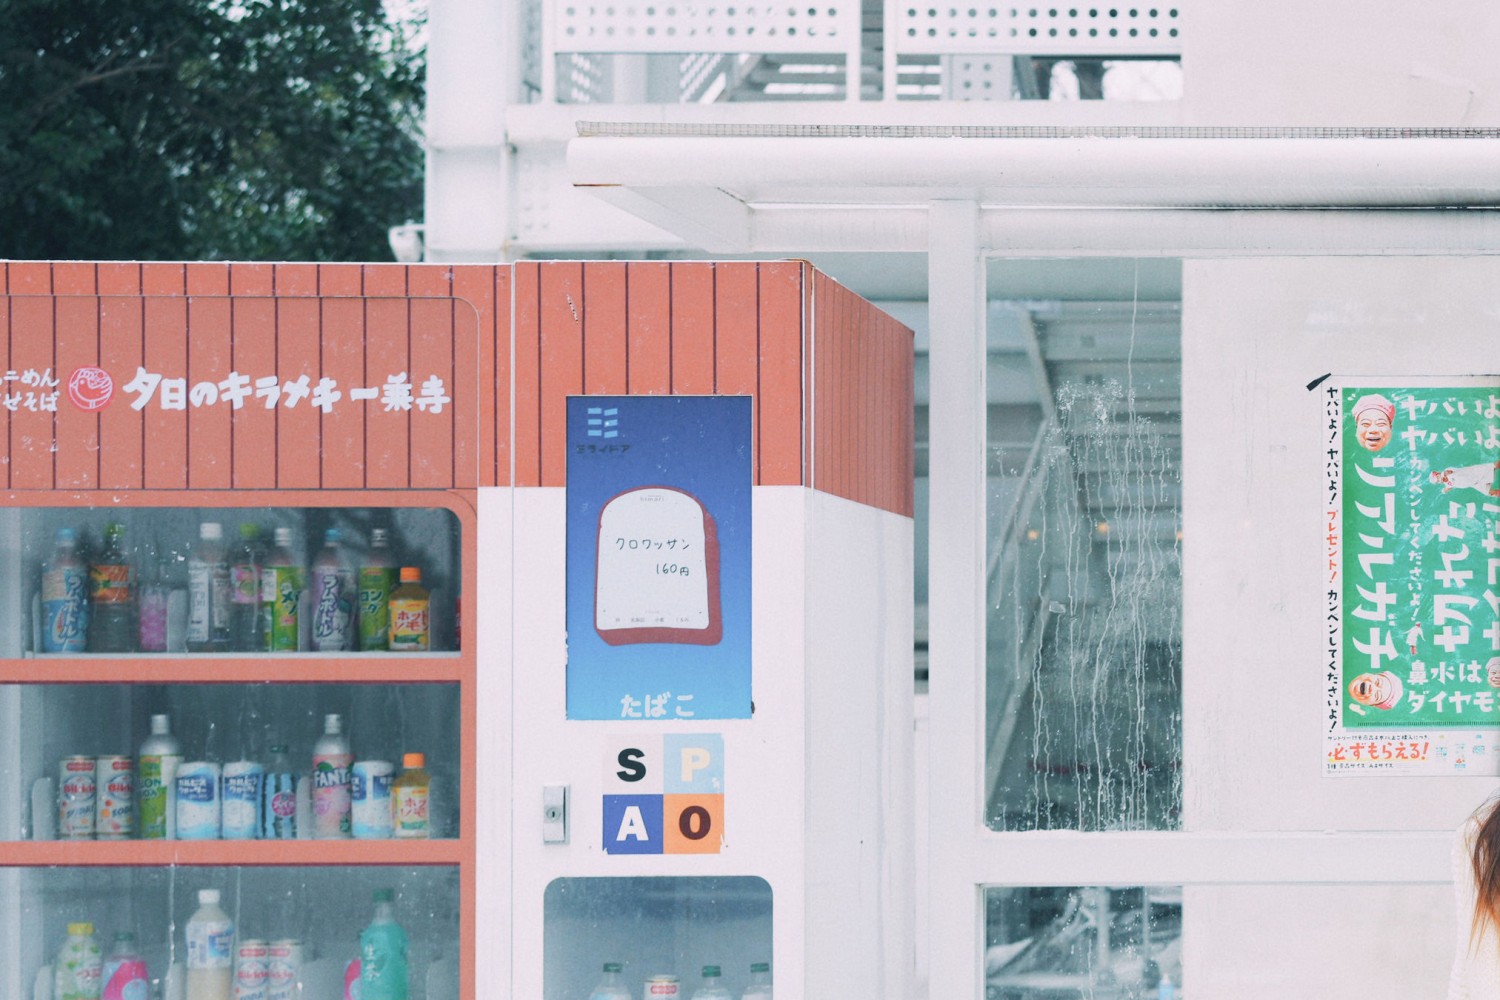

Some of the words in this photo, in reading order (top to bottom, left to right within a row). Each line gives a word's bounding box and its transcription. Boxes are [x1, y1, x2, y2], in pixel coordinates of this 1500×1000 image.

[616, 538, 690, 551] クロワッサン
[656, 563, 689, 577] 160円
[1408, 659, 1482, 685] 鼻水は
[620, 691, 695, 718] たばこ
[1328, 742, 1429, 760] 必ずもらえる!
